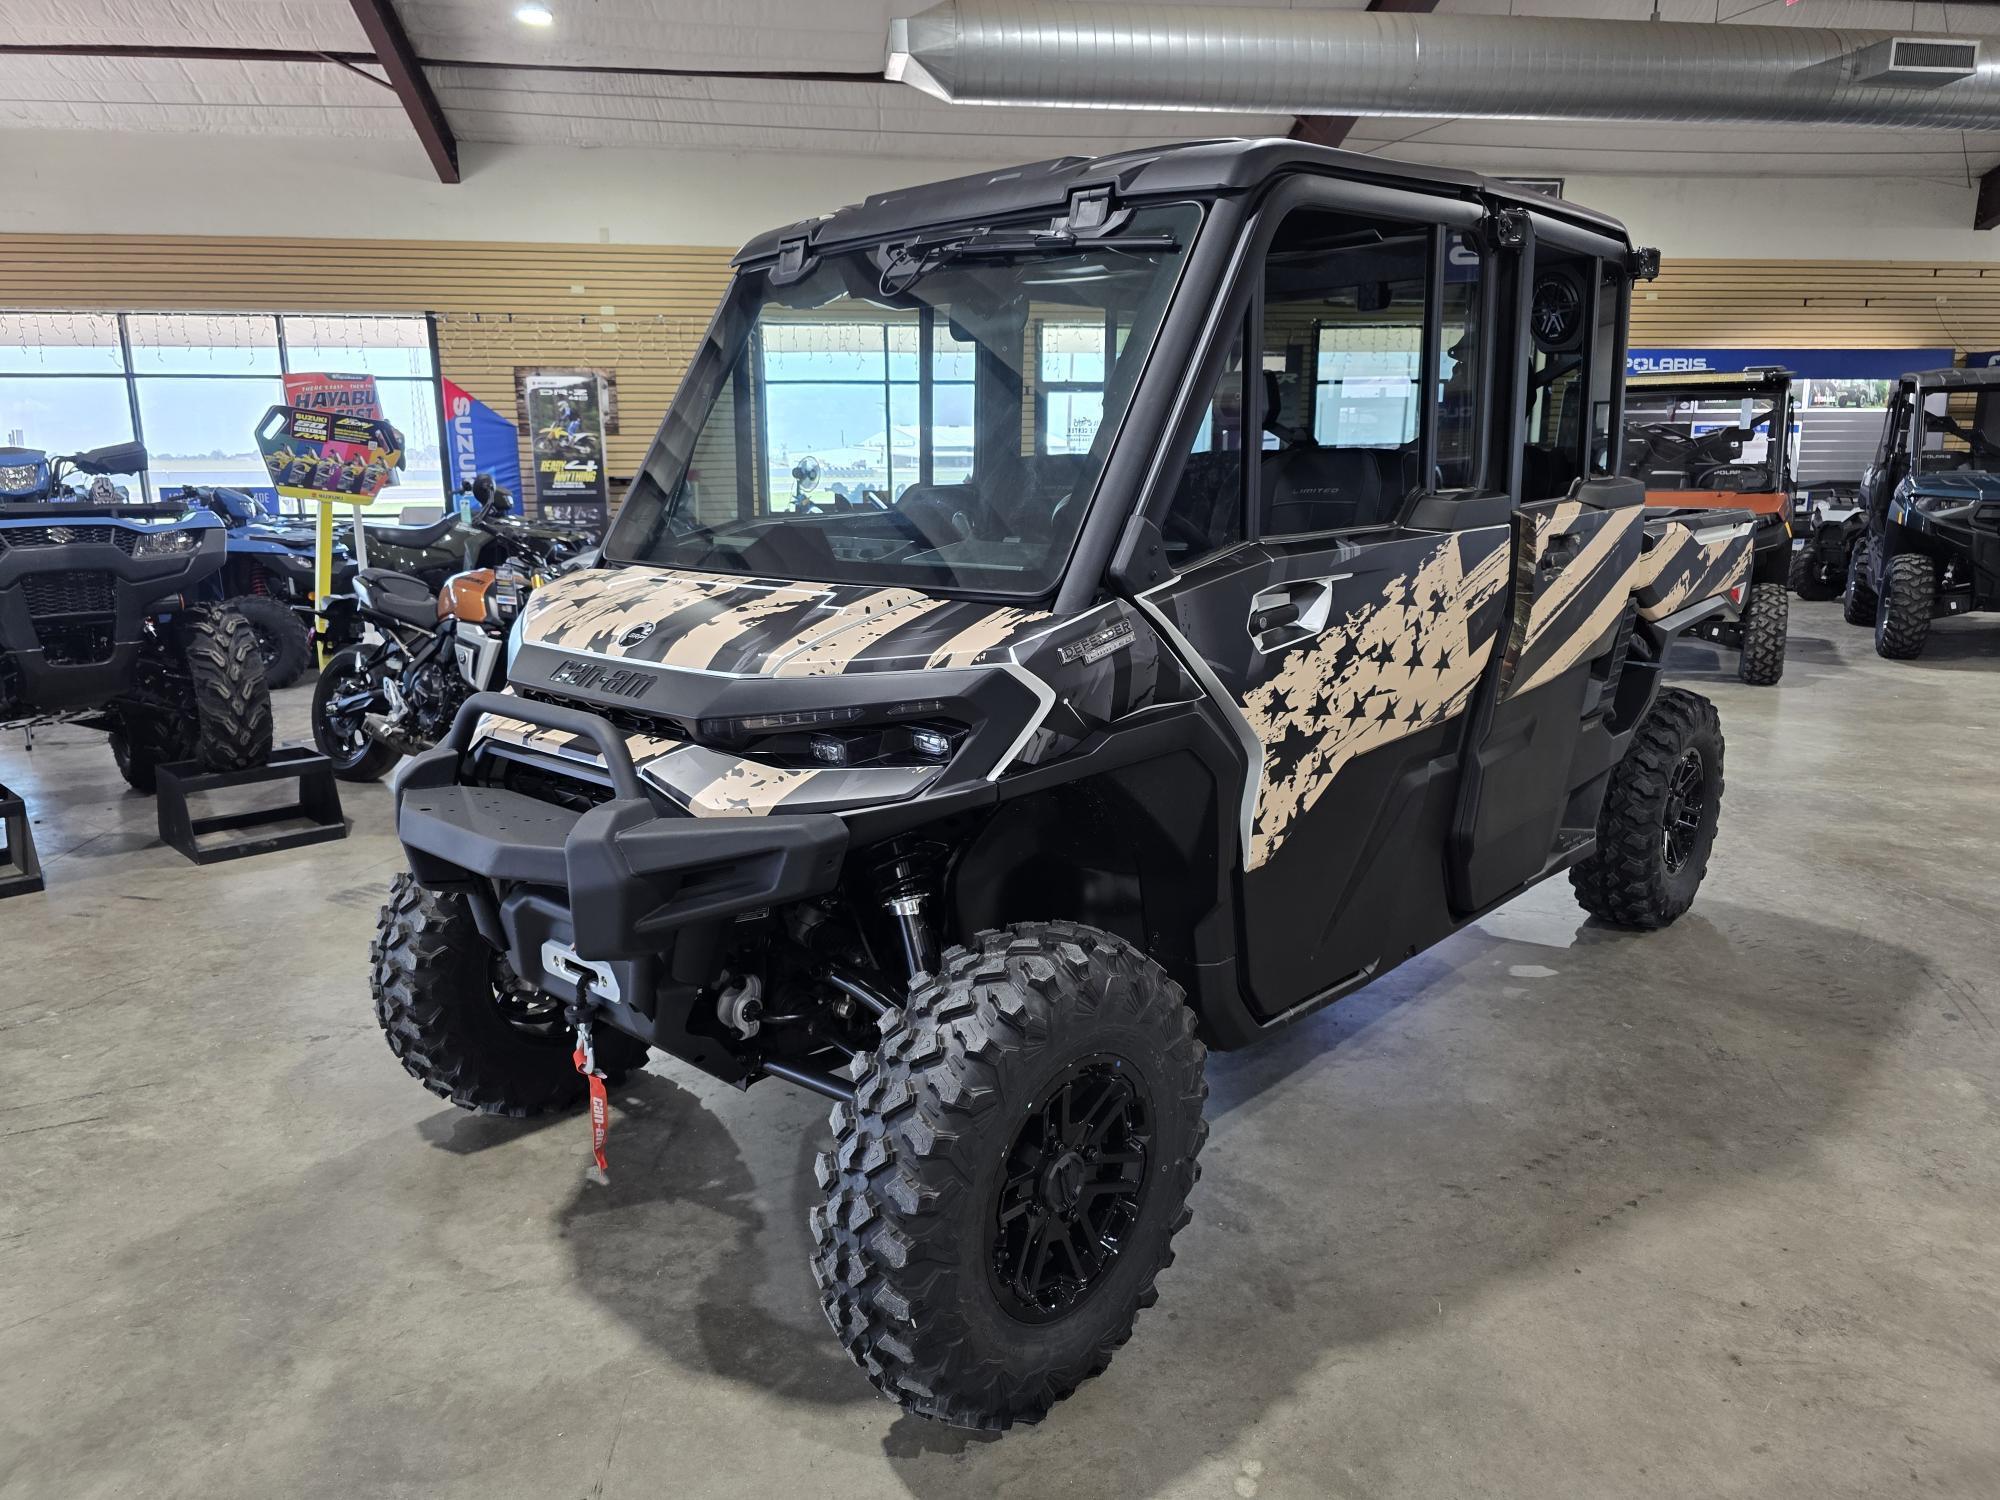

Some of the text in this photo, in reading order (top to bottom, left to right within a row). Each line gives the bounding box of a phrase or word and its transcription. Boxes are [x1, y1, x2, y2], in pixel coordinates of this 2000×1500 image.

[295, 413, 328, 424] SUZUKI
[1292, 487, 1340, 495] LIMITED
[1064, 619, 1132, 659] DEFENDER
[549, 659, 658, 699] can-am
